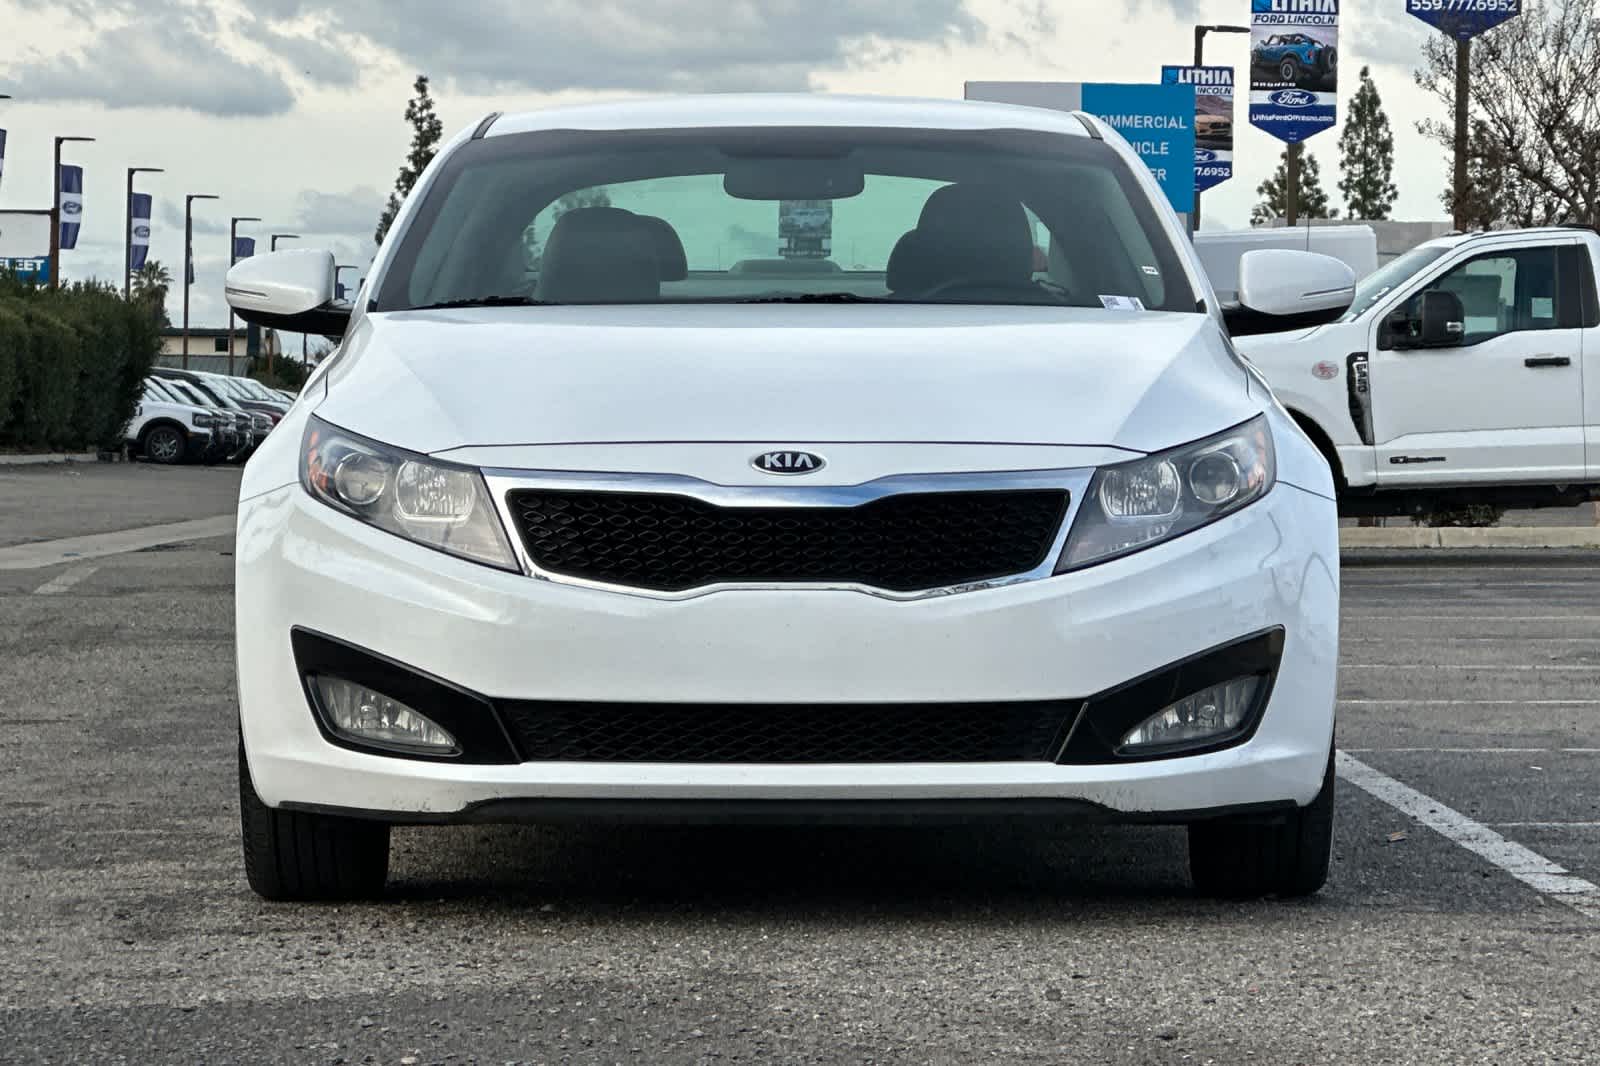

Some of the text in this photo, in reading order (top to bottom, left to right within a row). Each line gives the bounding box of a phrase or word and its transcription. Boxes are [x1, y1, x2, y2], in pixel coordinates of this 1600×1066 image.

[1271, 0, 1337, 12] LITHIA
[1411, 0, 1518, 11] 559.777.6952
[1254, 14, 1336, 25] FORD LINCOLN
[1178, 69, 1232, 84] LITHIA
[1100, 115, 1188, 128] OMMERCIAL
[1132, 142, 1169, 155] ICLE
[1194, 167, 1230, 176] 7.6952
[764, 453, 814, 468] KIA
